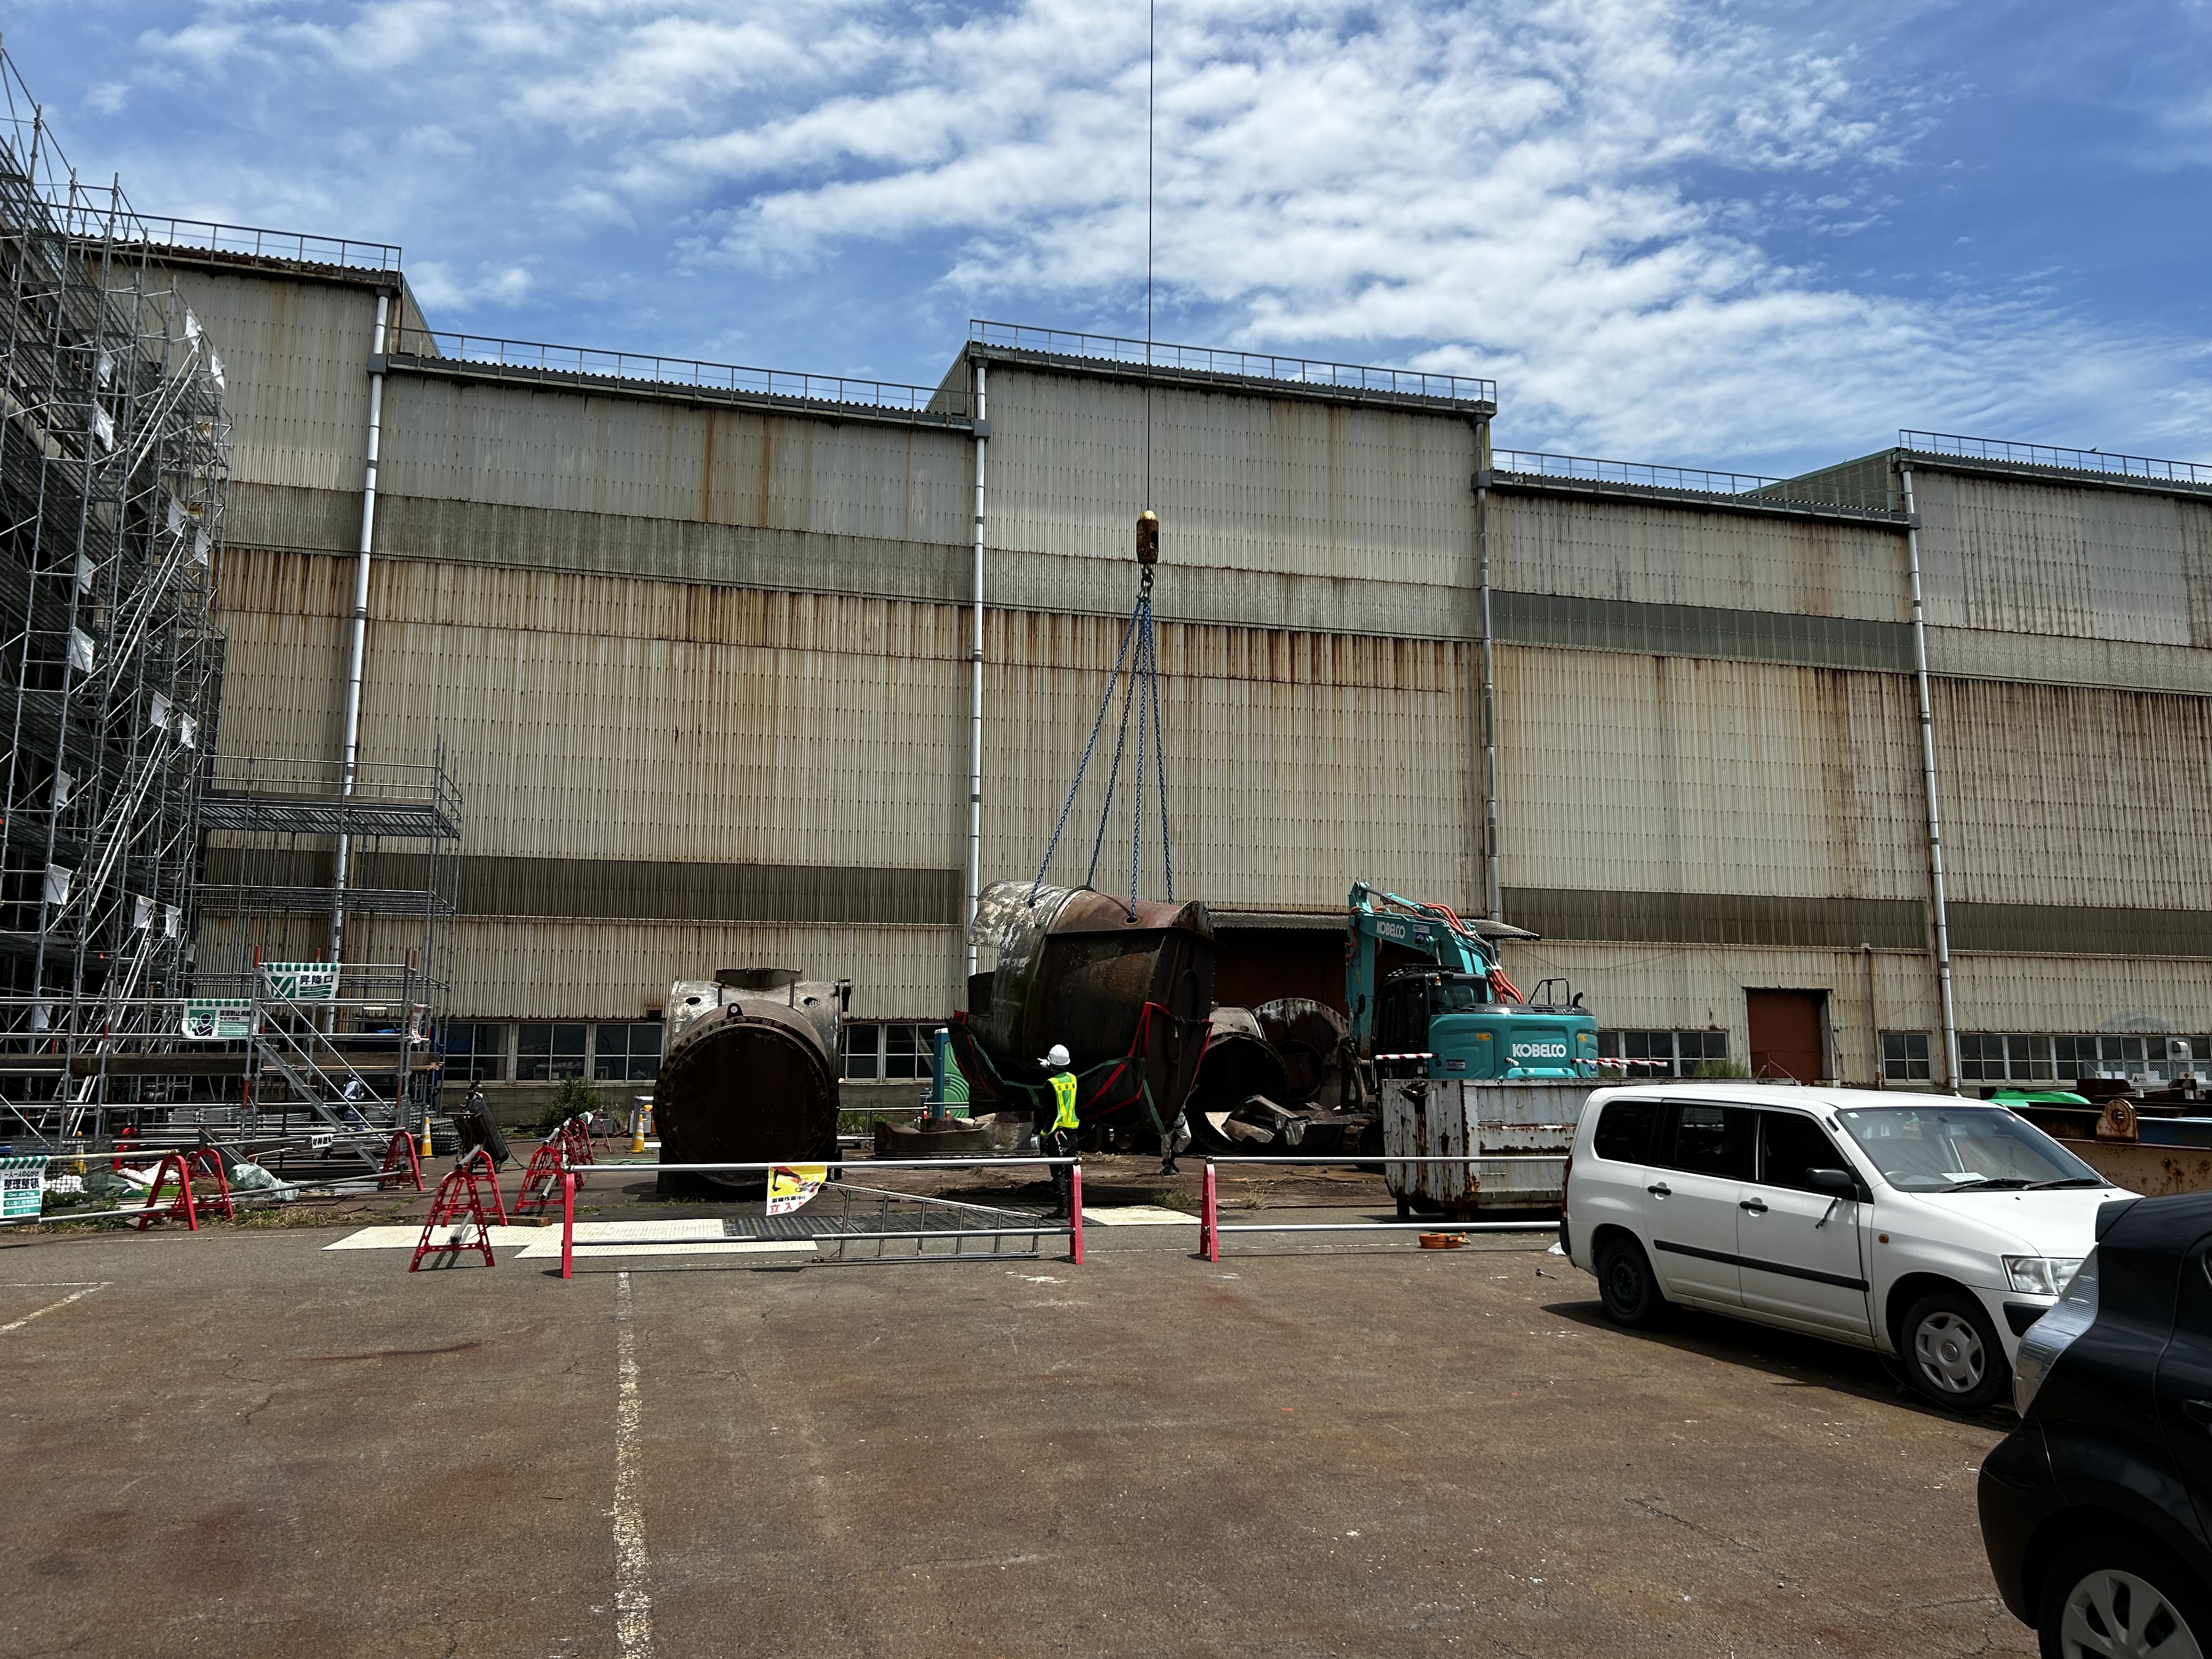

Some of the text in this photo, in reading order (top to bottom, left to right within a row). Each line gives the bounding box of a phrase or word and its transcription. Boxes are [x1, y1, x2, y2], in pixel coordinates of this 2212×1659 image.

[1376, 921, 1406, 939] KOBELCO
[300, 975, 334, 985] 昇降口
[1512, 1043, 1566, 1058] KOBELCO
[4, 1178, 40, 1190] 整理整頓
